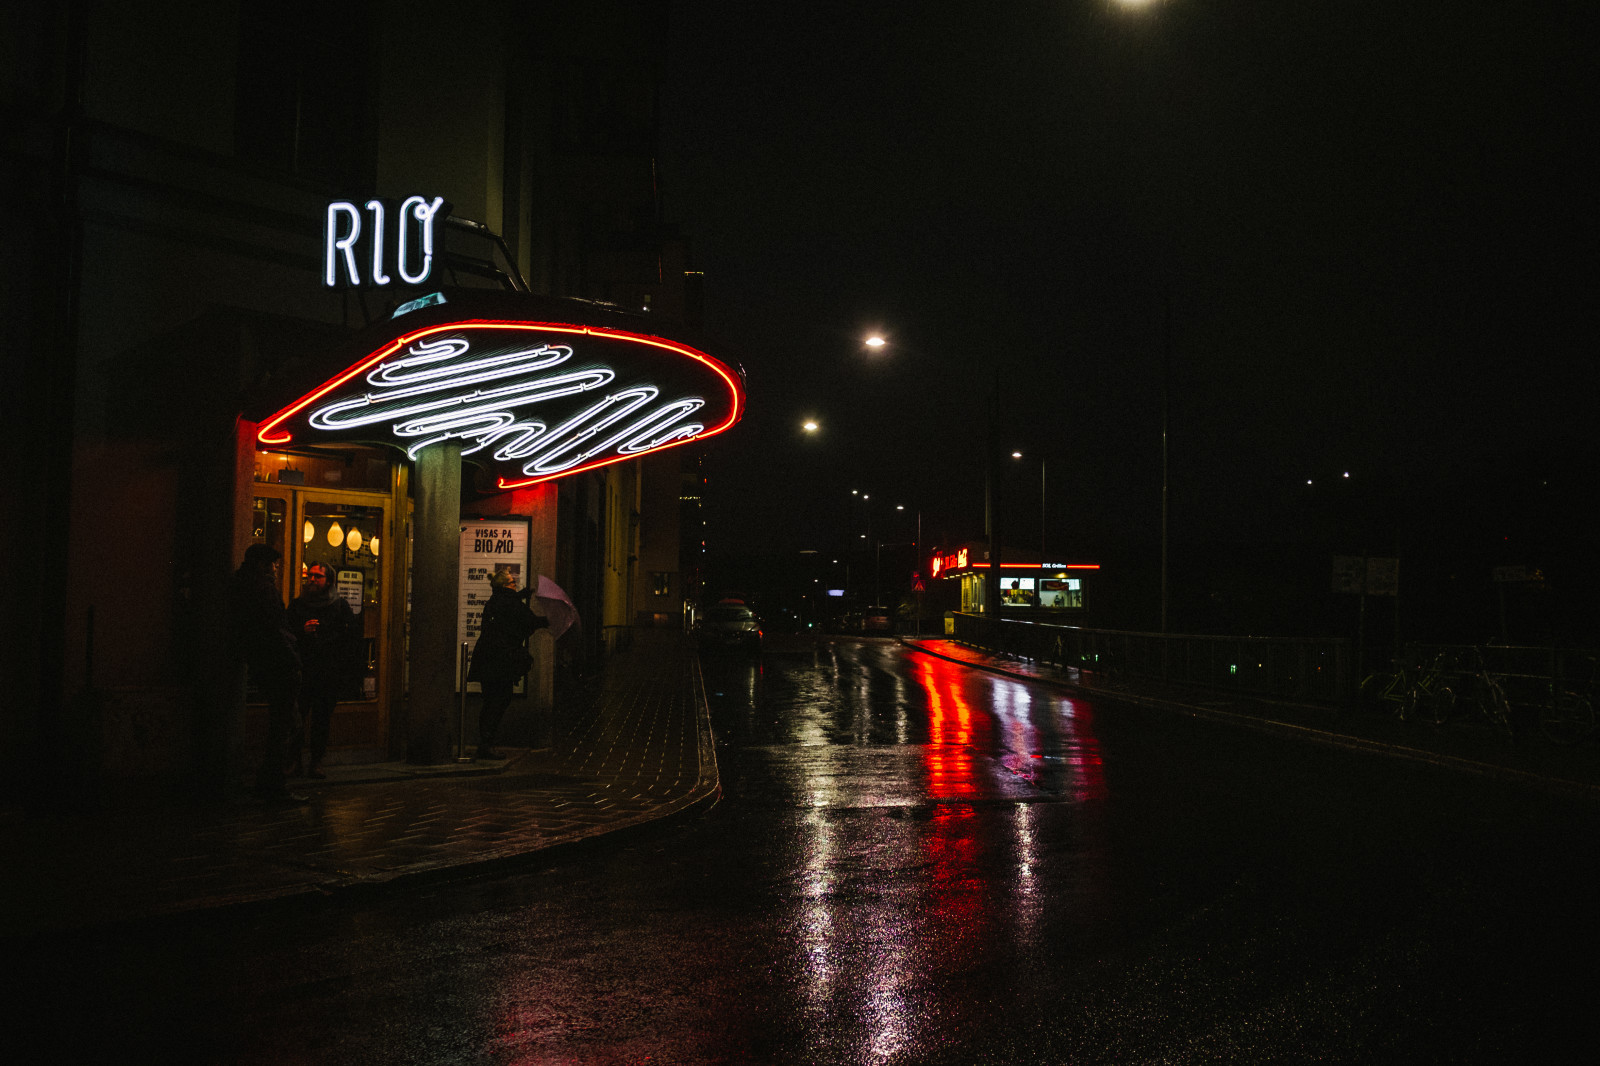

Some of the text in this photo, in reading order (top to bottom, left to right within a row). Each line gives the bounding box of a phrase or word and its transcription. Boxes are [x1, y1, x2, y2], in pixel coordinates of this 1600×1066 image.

[326, 195, 444, 287] RIO
[475, 529, 498, 538] VISAS
[474, 539, 514, 554] BIO RIO
